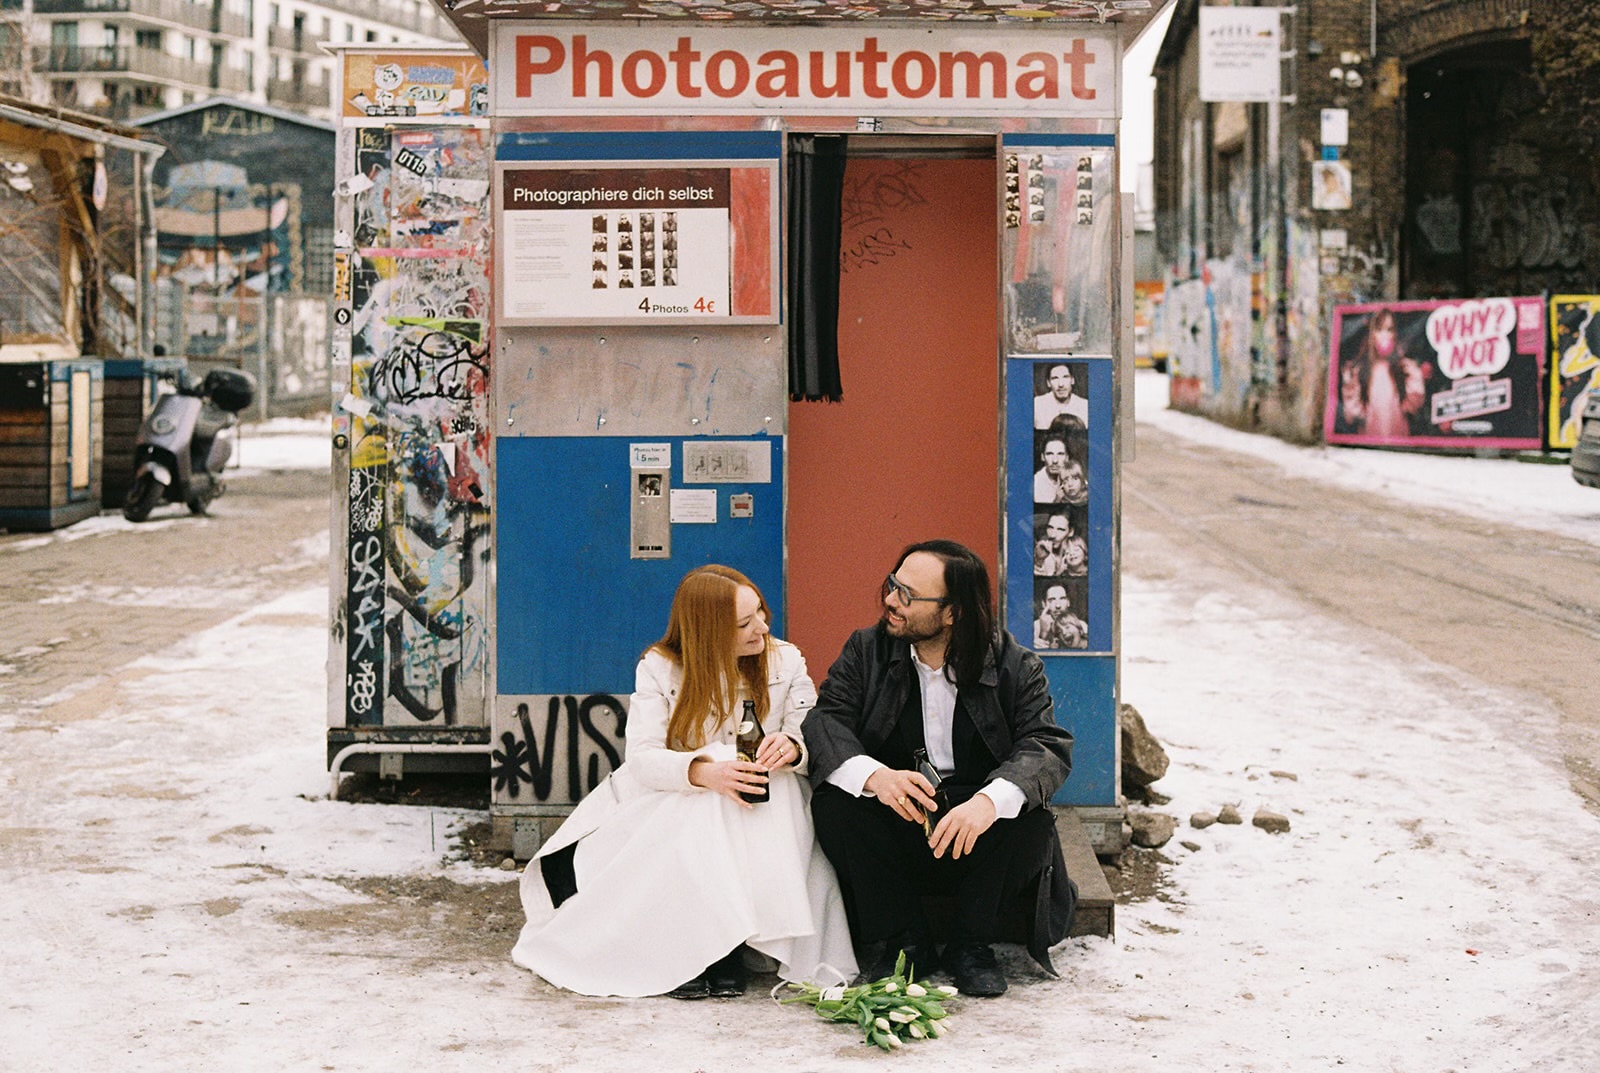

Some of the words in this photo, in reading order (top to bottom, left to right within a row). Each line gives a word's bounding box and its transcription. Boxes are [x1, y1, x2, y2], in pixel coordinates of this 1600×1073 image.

[514, 34, 1096, 99] Photoautomat
[513, 187, 628, 204] Photographiere
[632, 187, 664, 201] dich
[668, 187, 714, 201] selbst
[638, 298, 651, 313] 4
[652, 304, 689, 313] Photos
[693, 297, 716, 313] 4€
[1435, 305, 1506, 342] WHY?
[1450, 337, 1499, 371] NOT
[641, 454, 647, 462] 5
